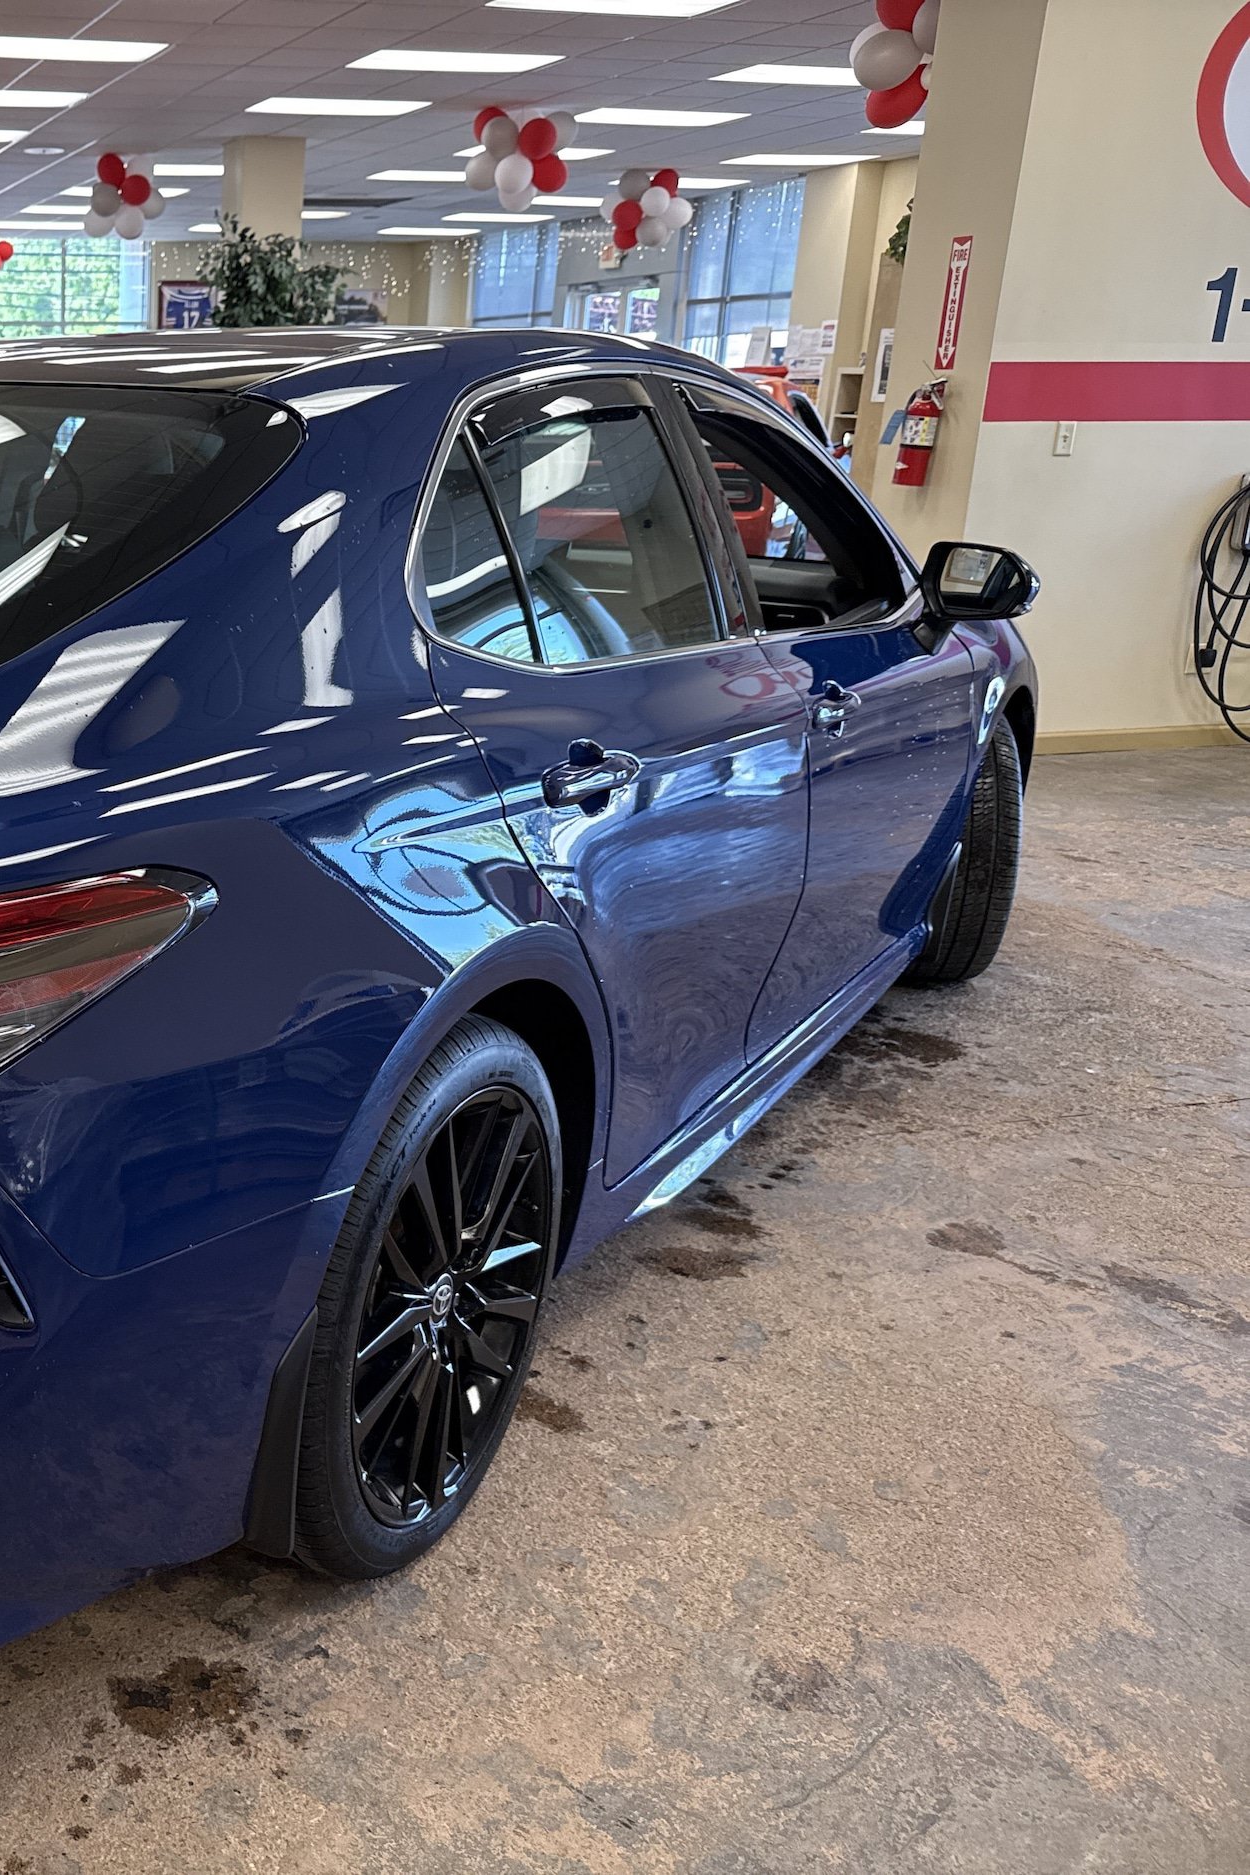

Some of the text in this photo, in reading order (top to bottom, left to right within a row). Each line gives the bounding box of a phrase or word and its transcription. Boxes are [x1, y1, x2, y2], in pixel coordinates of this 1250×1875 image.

[952, 248, 968, 262] FIRE
[183, 310, 200, 329] 17
[942, 266, 961, 360] EXTINGUISHER
